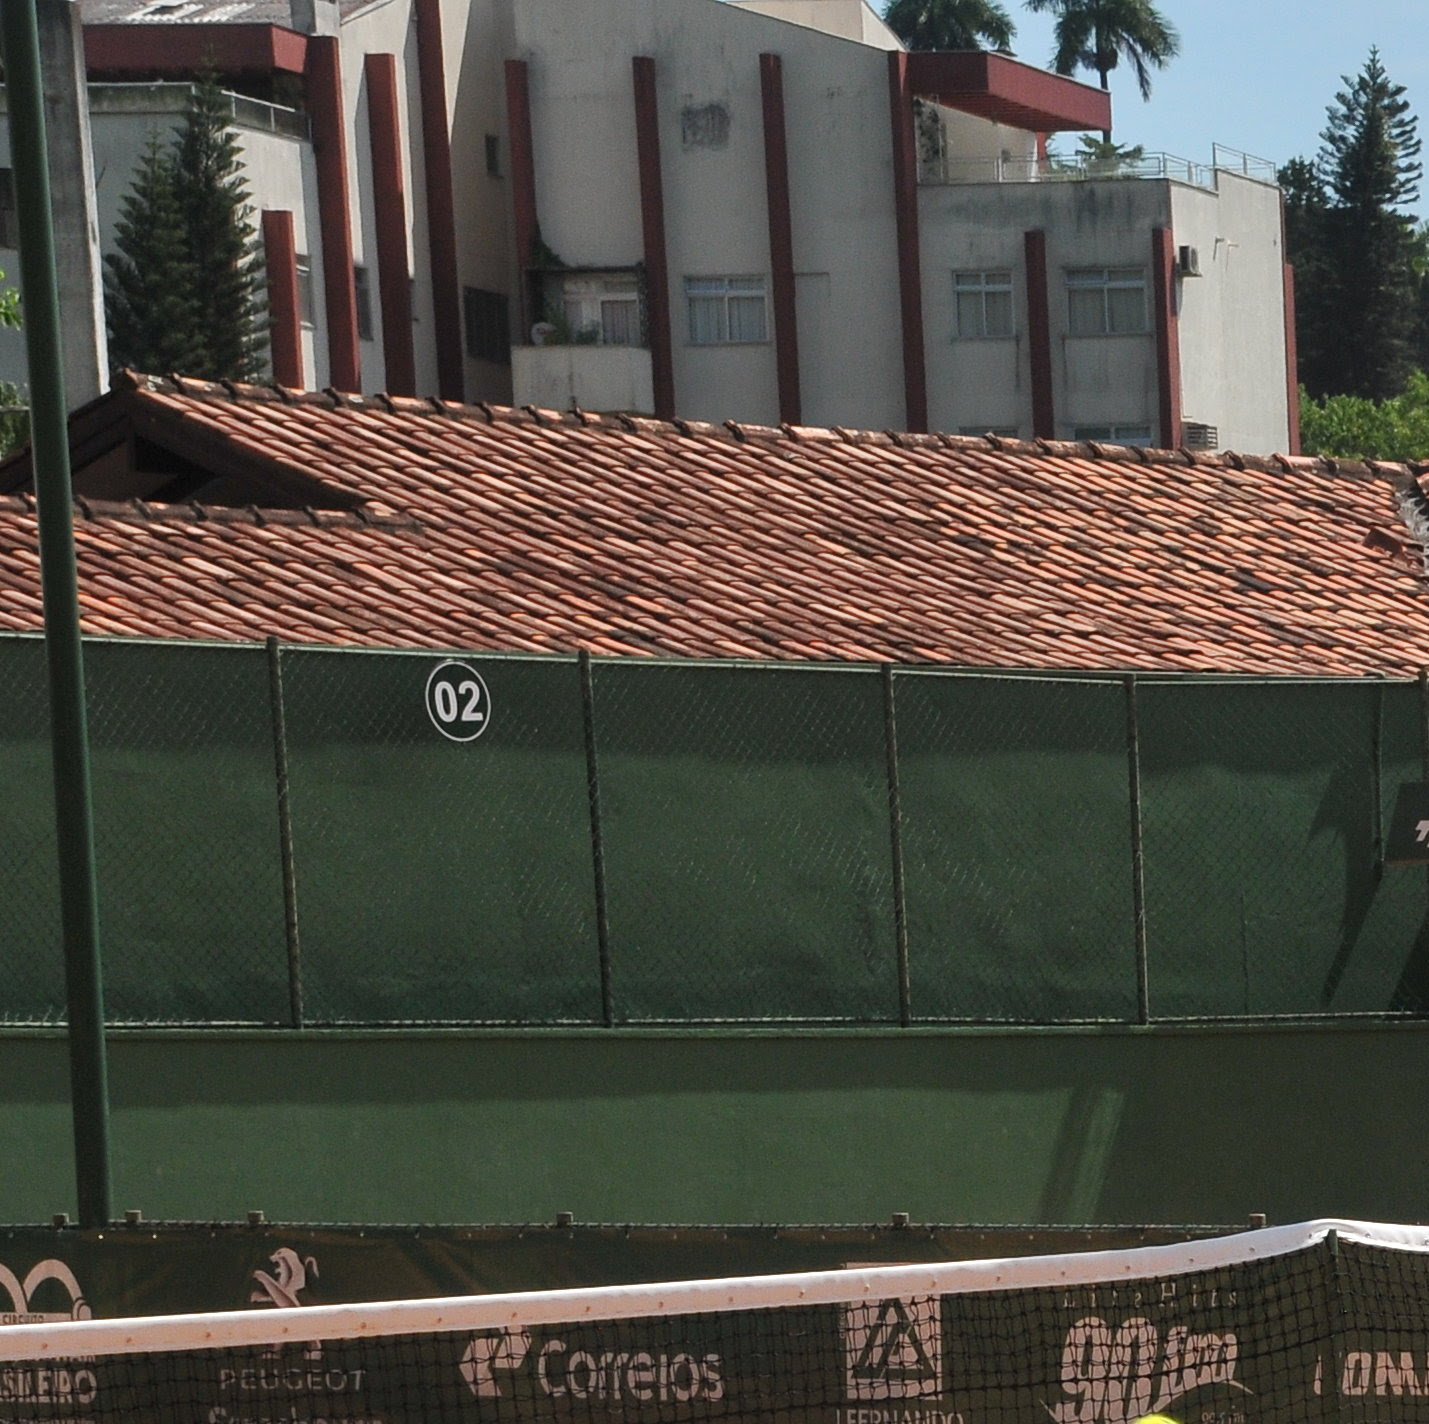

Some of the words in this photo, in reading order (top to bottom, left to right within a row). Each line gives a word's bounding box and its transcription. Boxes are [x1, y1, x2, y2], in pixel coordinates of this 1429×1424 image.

[434, 680, 484, 723] 02
[0, 1367, 97, 1404] SILEIRO
[220, 1368, 367, 1391] PEUGEOT
[538, 1340, 725, 1402] Correios
